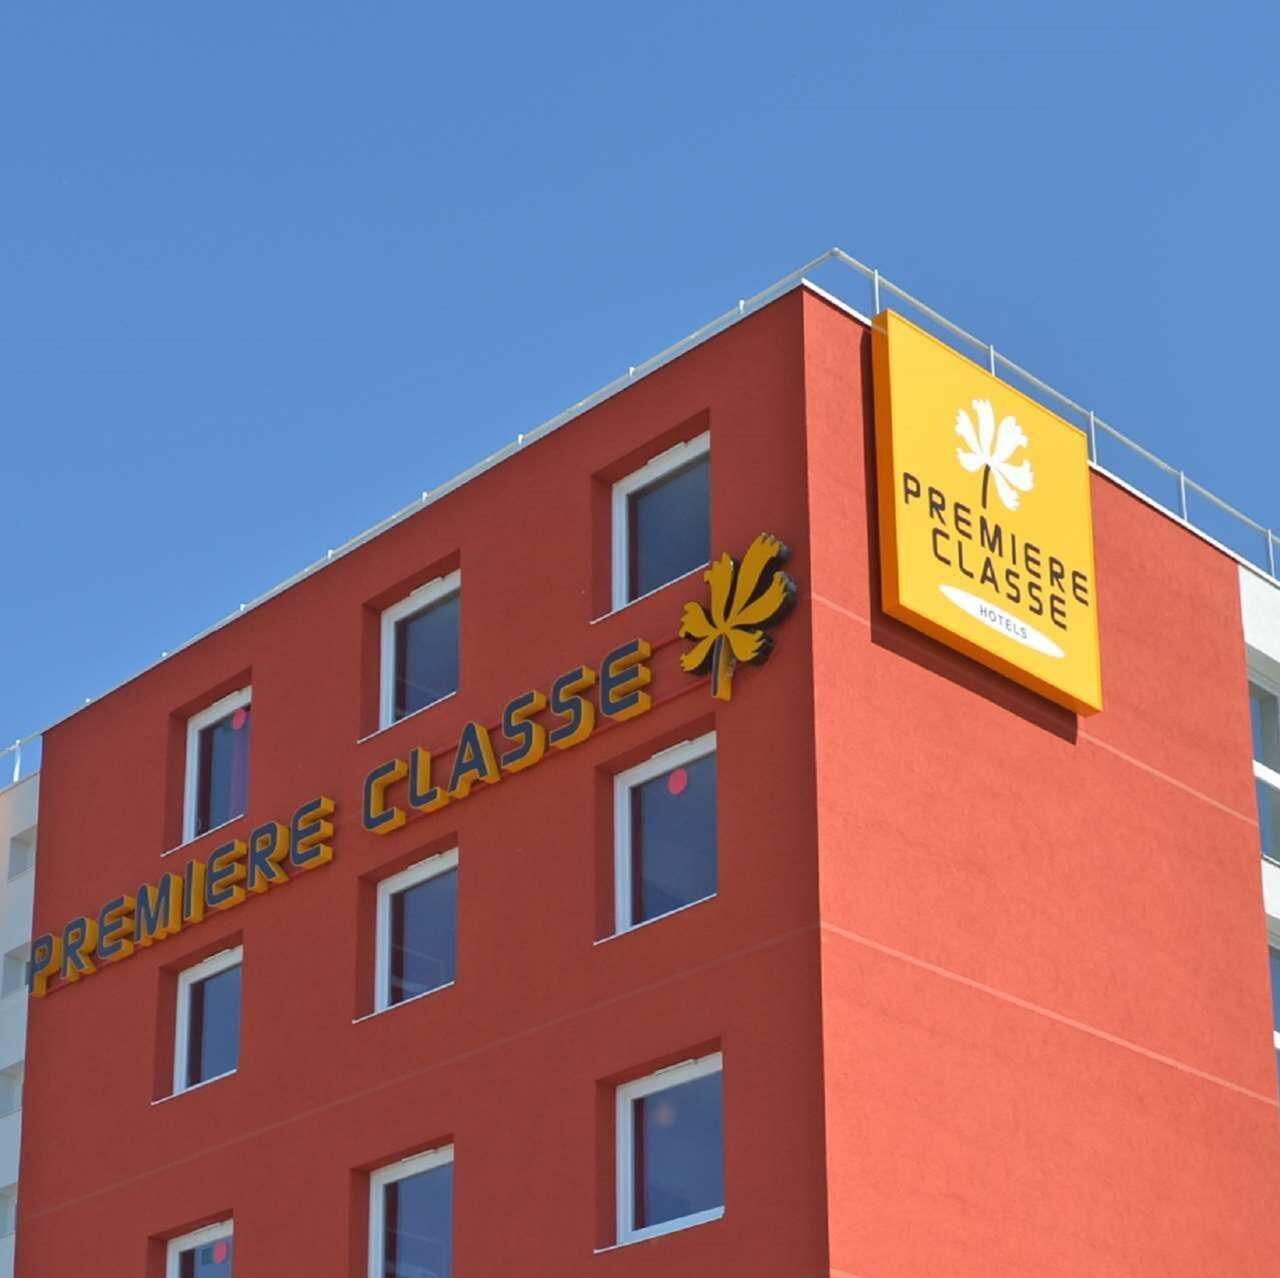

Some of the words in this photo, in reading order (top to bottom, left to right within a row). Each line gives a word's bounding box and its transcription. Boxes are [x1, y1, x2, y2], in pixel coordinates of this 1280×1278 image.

[903, 471, 1089, 607] PREMIERE
[932, 527, 1068, 632] CLASSE
[979, 604, 1028, 640] HOTELS
[28, 795, 336, 999] PREMIERE
[361, 637, 652, 835] CLASSE
